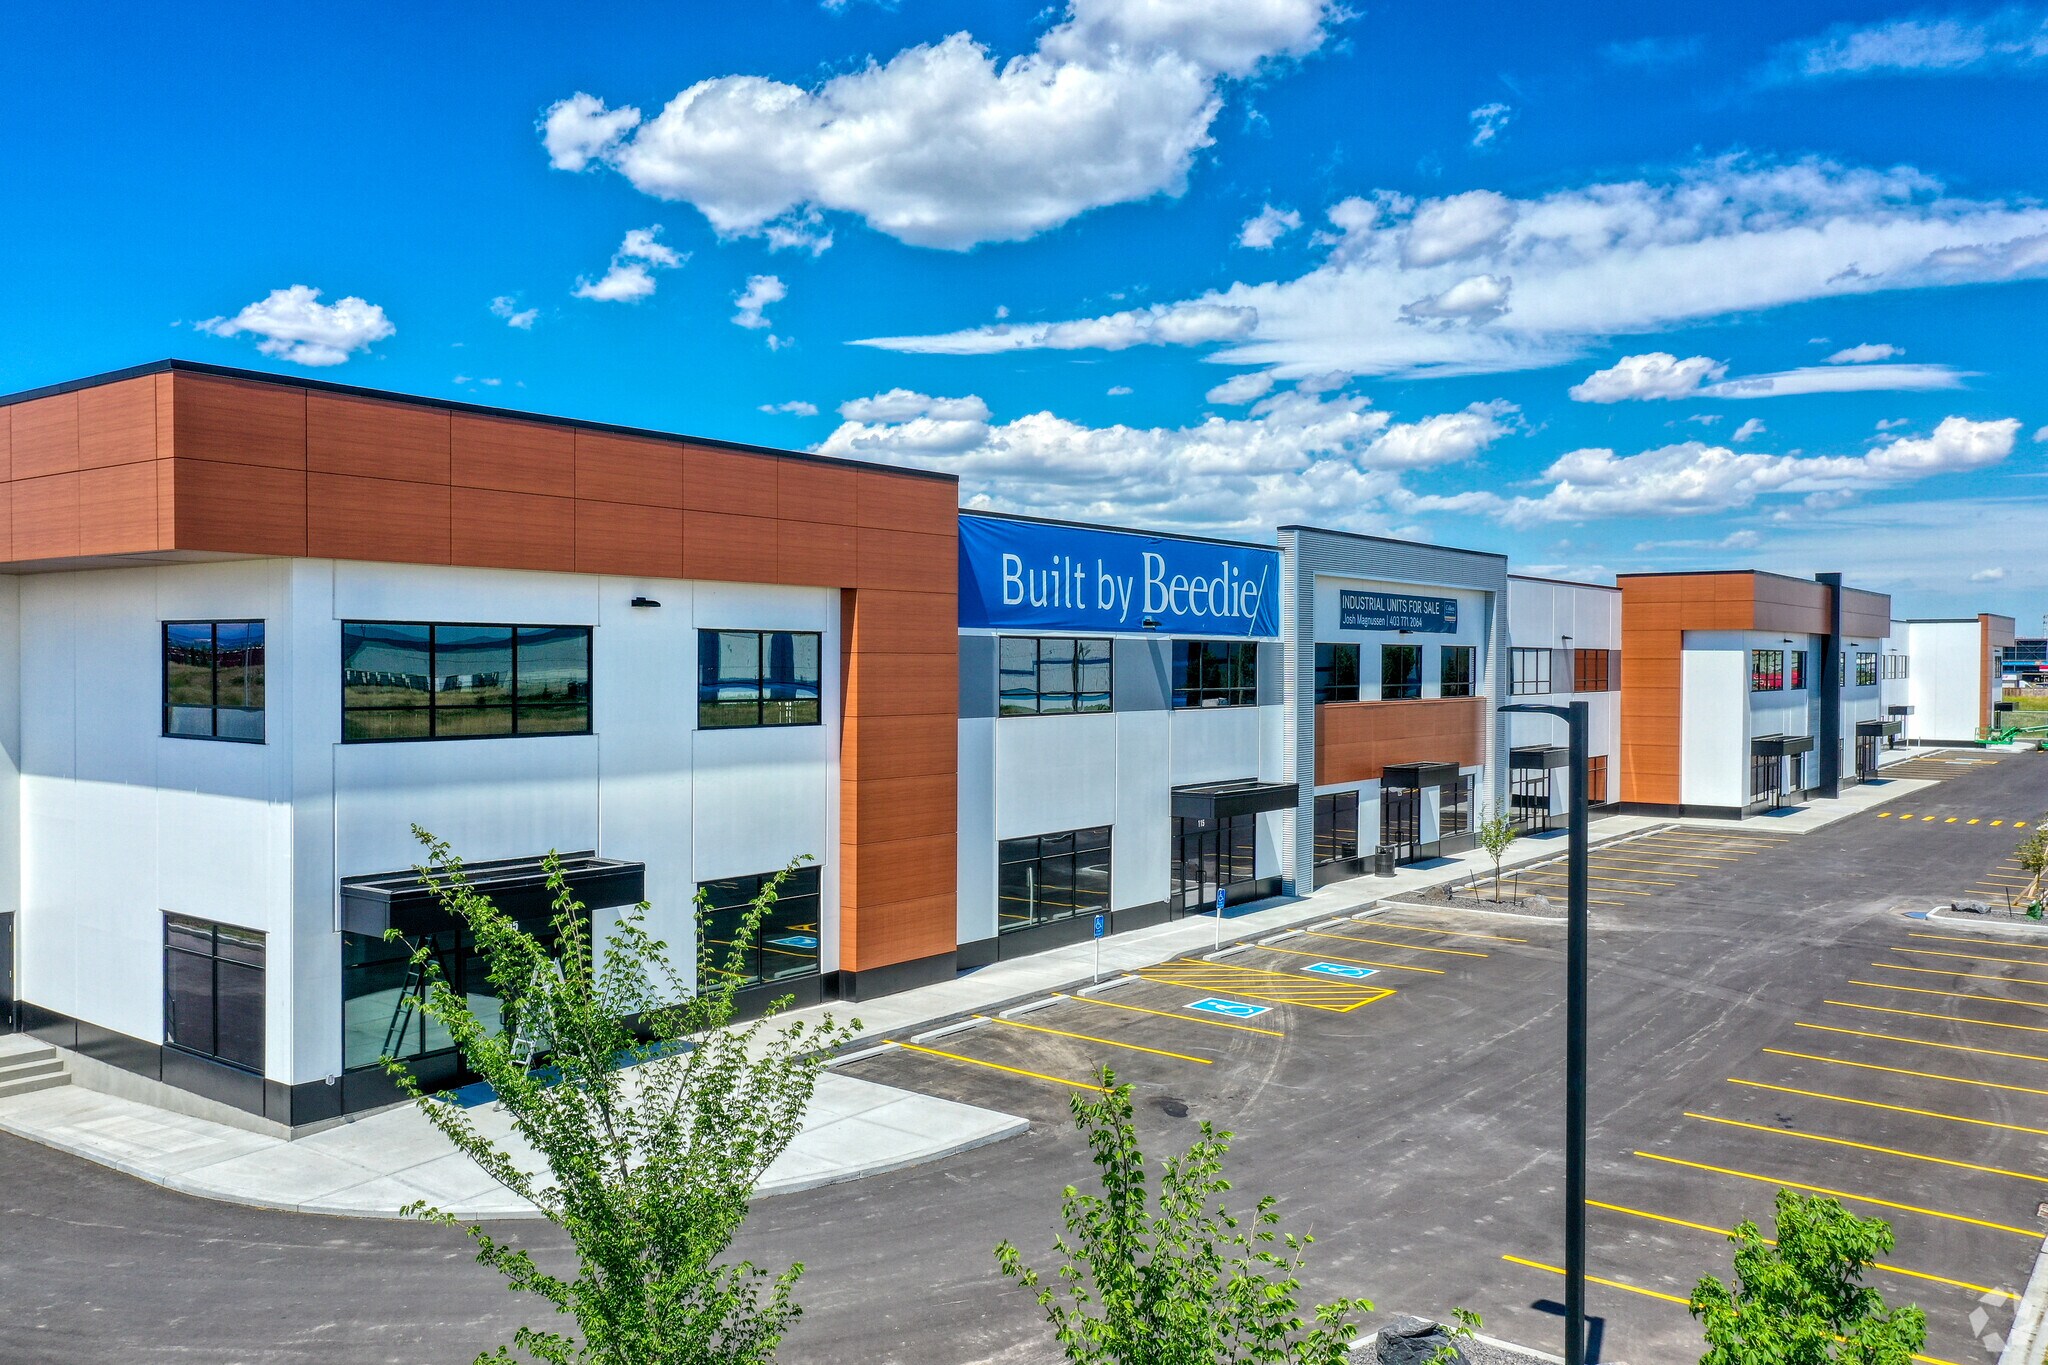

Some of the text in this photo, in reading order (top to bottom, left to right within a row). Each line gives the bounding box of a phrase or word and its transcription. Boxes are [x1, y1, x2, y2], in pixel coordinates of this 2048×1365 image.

[1002, 553, 1086, 609] Built
[1097, 559, 1134, 624] by
[1342, 595, 1385, 611] INDUSTRIAL
[1387, 598, 1407, 613] UNITS
[1409, 600, 1422, 614] FOR
[1423, 601, 1440, 615] SALE
[1342, 613, 1356, 625] Josh
[1357, 614, 1385, 628] Magnussen
[1390, 616, 1400, 627] 403
[1401, 616, 1409, 627] 771
